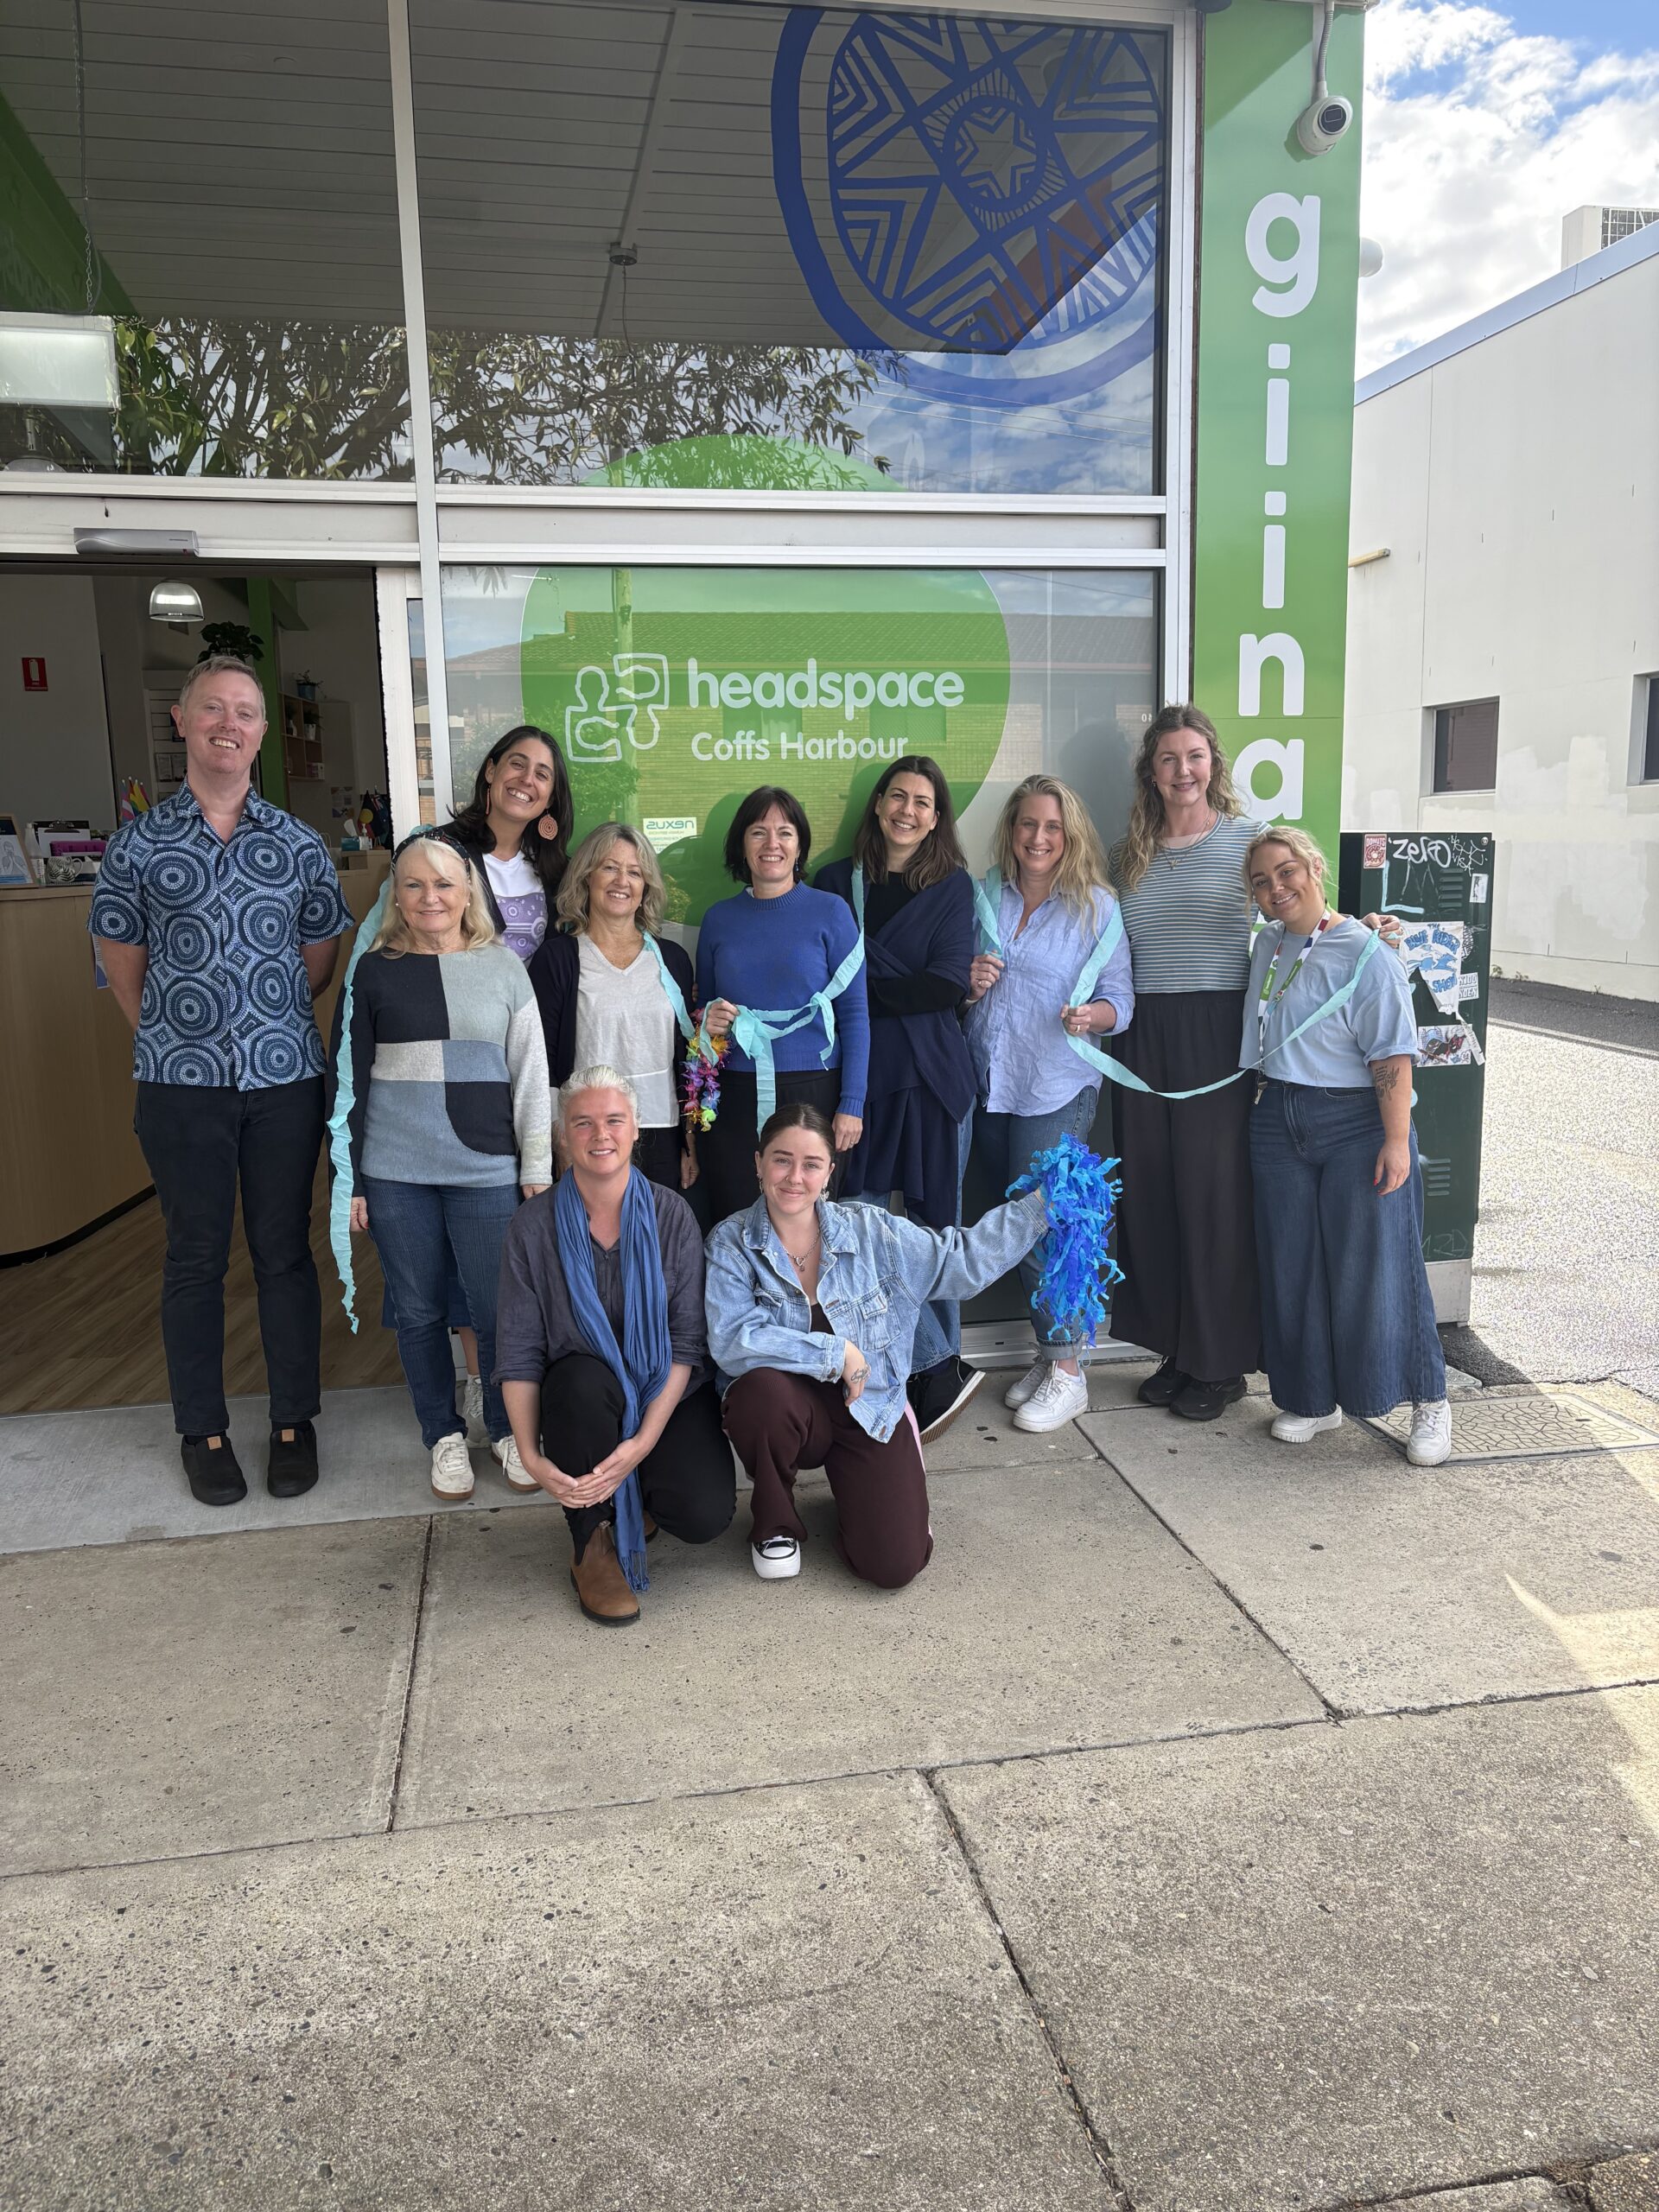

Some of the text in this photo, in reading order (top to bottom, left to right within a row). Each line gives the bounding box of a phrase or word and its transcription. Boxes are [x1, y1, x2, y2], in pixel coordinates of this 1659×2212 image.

[1231, 192, 1321, 950] giina
[688, 658, 965, 721] headspace
[691, 729, 908, 761] Coffs Harbour
[1366, 837, 1386, 847] DONUTS
[1404, 930, 1428, 950] BLUE
[1432, 930, 1460, 954] RIDER
[1433, 973, 1458, 993] SHOW
